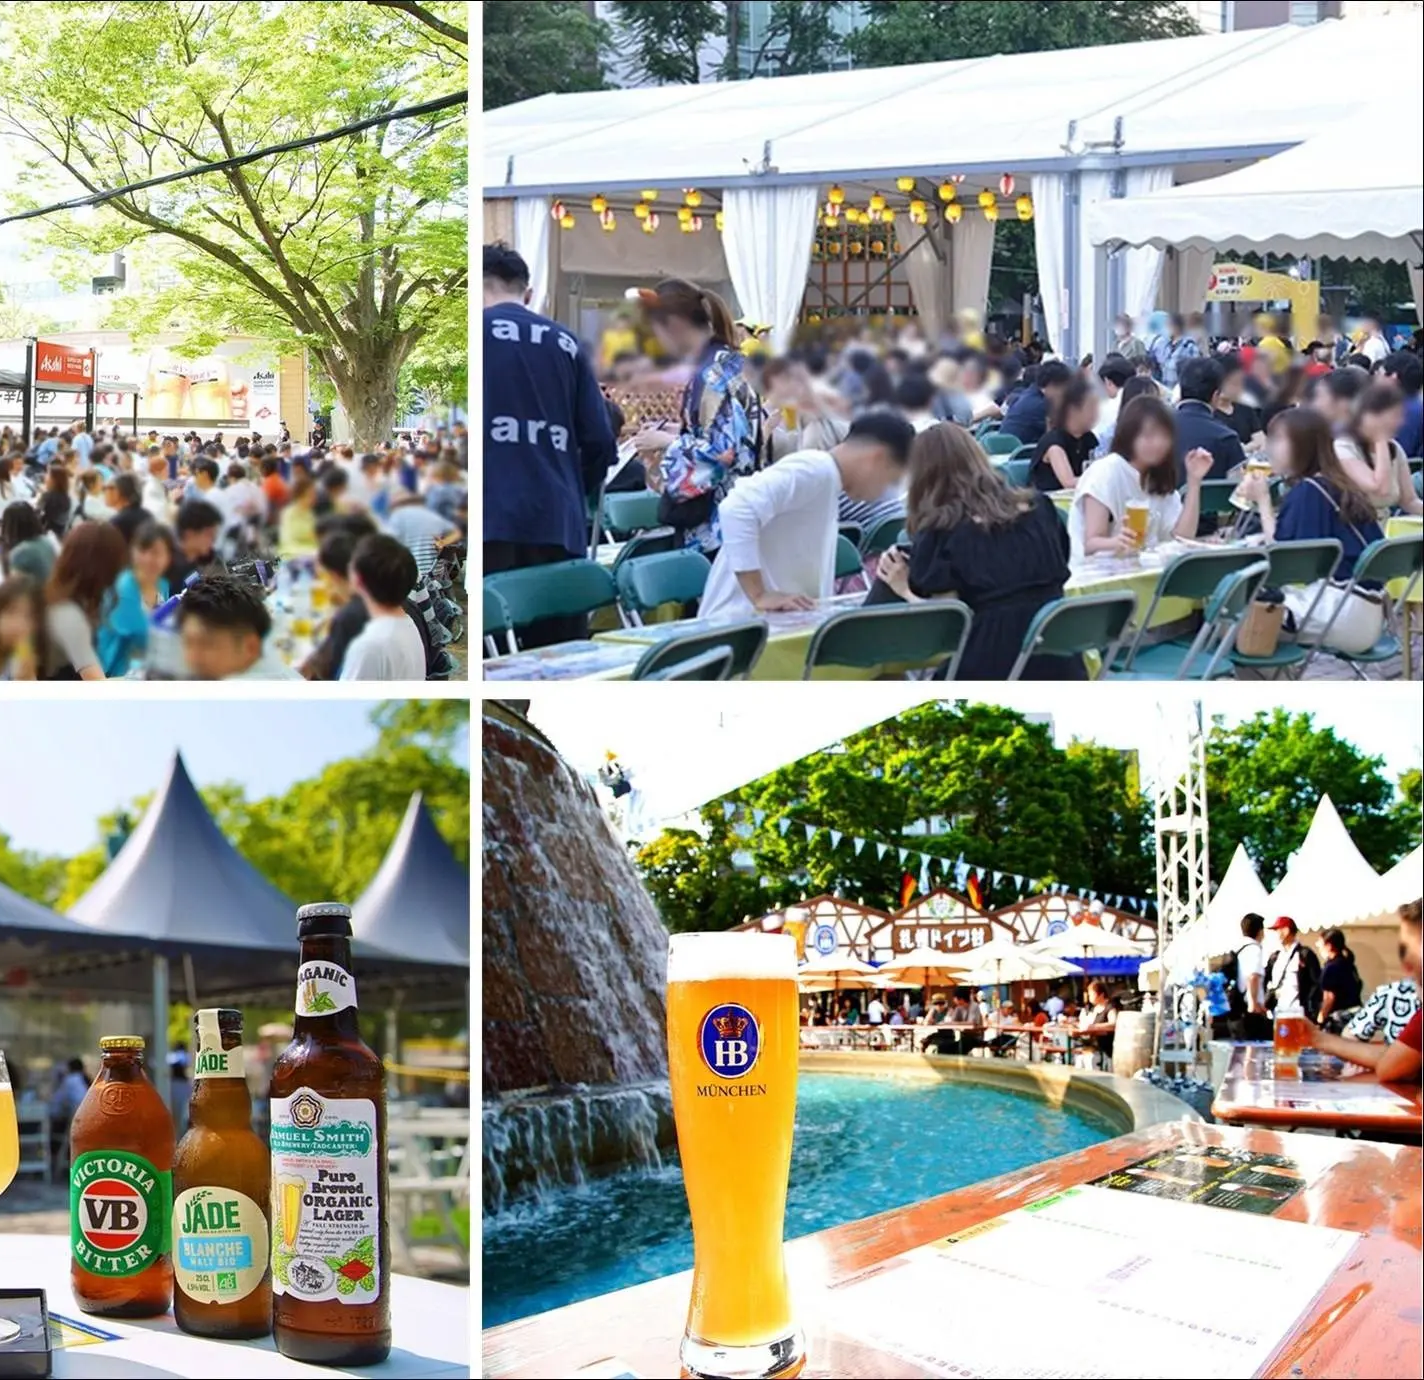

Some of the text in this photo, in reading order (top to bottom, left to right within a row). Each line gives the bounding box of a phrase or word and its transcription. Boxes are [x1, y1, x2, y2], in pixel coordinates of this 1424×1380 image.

[41, 355, 62, 373] Asahi
[253, 371, 275, 380] Asahi
[490, 415, 569, 452] ara
[299, 966, 348, 987] GANIC
[714, 1039, 749, 1067] HB
[196, 1053, 228, 1074] JADE
[696, 1084, 767, 1097] MÜNCHEN
[314, 1129, 365, 1143] SMITH
[72, 1157, 156, 1194] VICTORIA
[318, 1169, 356, 1182] Pure
[311, 1182, 364, 1194] Brewed
[303, 1194, 373, 1208] ORGANIC
[83, 1198, 140, 1231] VB
[182, 1200, 241, 1233] JADE
[313, 1208, 365, 1221] LAGER
[75, 1238, 153, 1272] BITTER
[183, 1240, 244, 1257] BLANCHE
